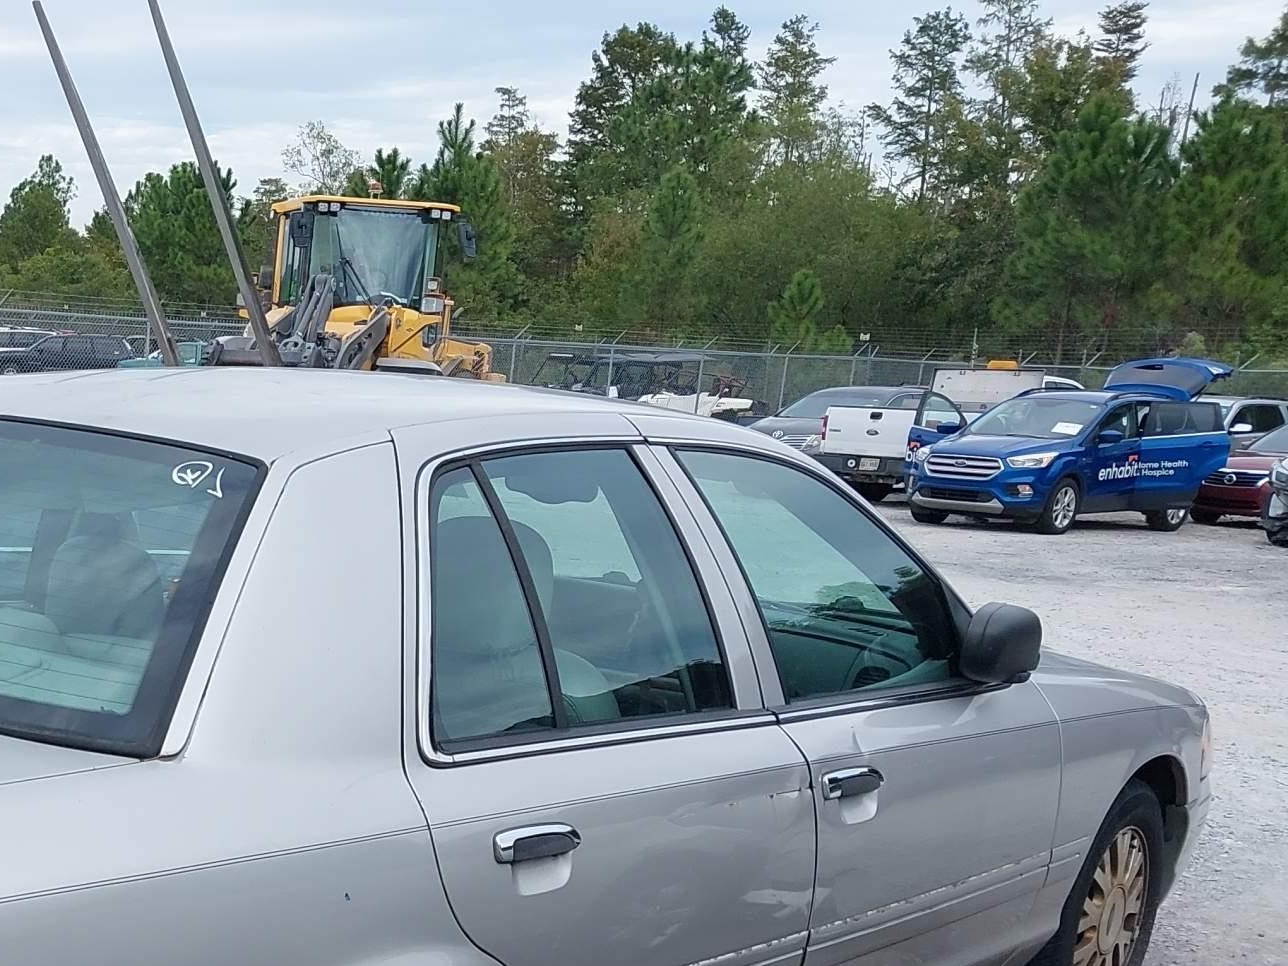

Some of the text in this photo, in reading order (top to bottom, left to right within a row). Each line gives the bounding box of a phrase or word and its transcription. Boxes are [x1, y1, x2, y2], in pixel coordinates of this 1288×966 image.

[1161, 460, 1189, 468] Health
[1098, 461, 1138, 480] enhabit
[1141, 468, 1175, 477] Hospice
